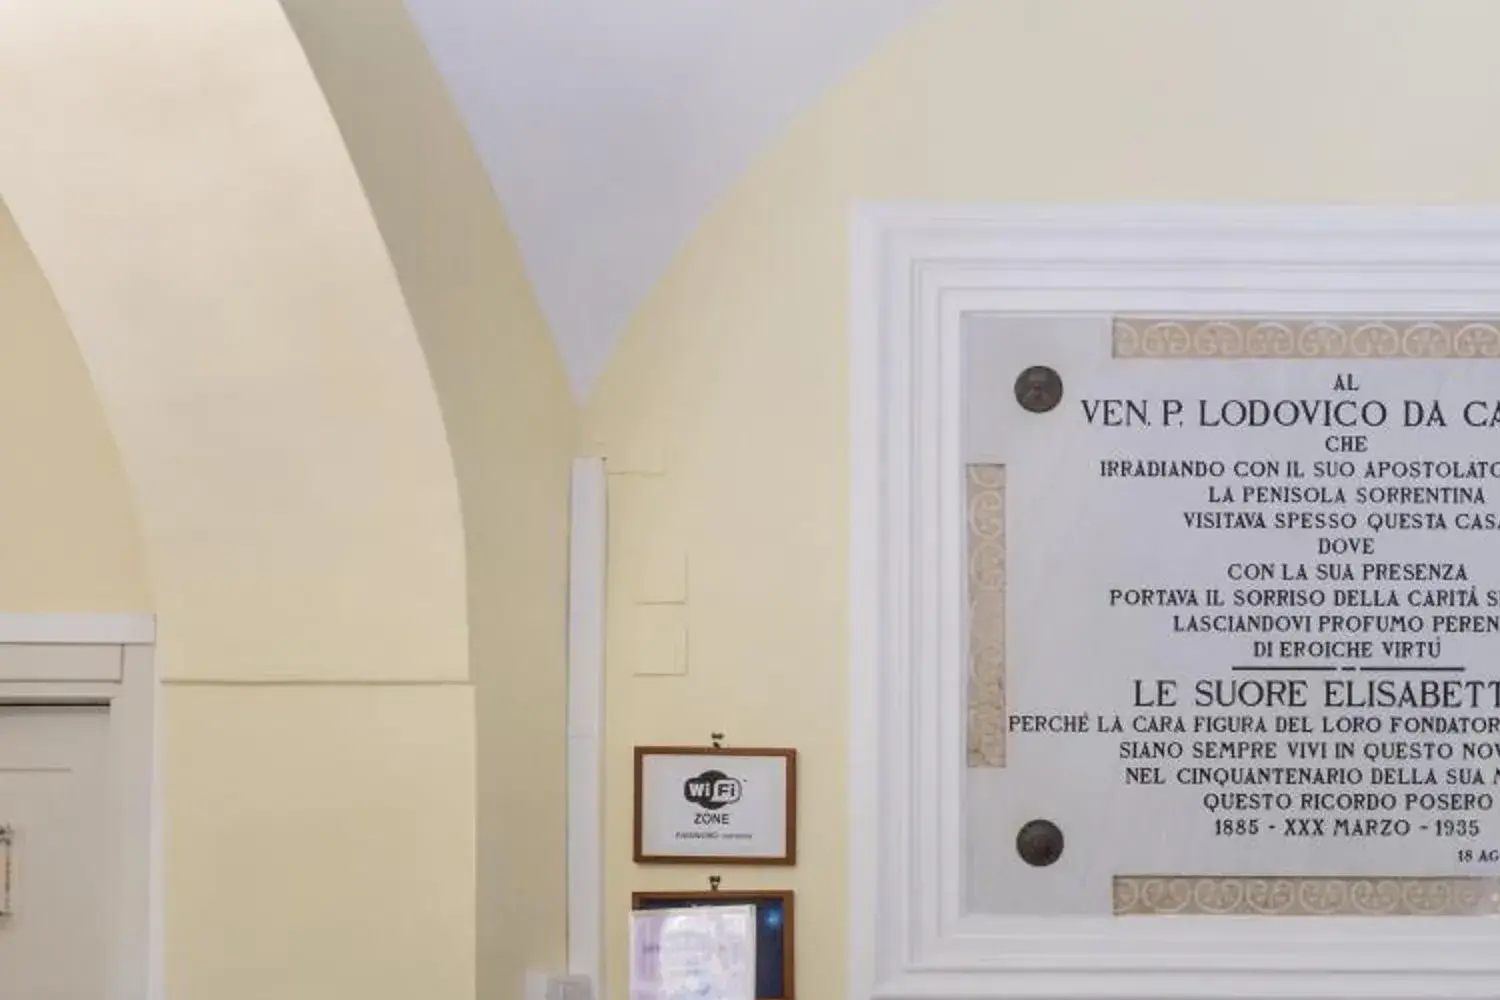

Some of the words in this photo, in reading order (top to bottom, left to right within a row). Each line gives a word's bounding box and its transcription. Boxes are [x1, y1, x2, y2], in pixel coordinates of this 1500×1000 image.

[1332, 372, 1360, 391] AL
[1079, 399, 1152, 428] VEN.
[1162, 399, 1184, 428] P.
[1199, 399, 1388, 428] LODOVICO
[1403, 399, 1449, 428] DA
[1324, 435, 1369, 453] CHE
[1099, 459, 1226, 479] IRRADIANDO
[1232, 460, 1280, 479] CON
[1285, 459, 1305, 479] IL
[1313, 460, 1356, 479] SUO
[1207, 485, 1236, 505] LA
[1242, 485, 1347, 505] PENISOLA
[1356, 486, 1486, 505] SORRENTINA
[1183, 511, 1268, 530] VISITAVA
[1273, 511, 1358, 530] SPESSO
[1366, 511, 1448, 534] QUESTA
[1317, 537, 1375, 556] DOVE
[1227, 562, 1276, 582] CON
[1280, 562, 1309, 582] LA
[1315, 563, 1355, 582] SUA
[1362, 562, 1469, 582] PRESENZA
[1108, 588, 1200, 607] PORTAVA
[1205, 588, 1226, 607] IL
[1232, 588, 1326, 607] SORRISO
[1333, 588, 1401, 608] DELLA
[1172, 614, 1312, 633] LASCIANDOVI
[1318, 615, 1425, 634] PROFUMO
[1253, 640, 1274, 658] DI
[1279, 640, 1373, 659] EROICHE
[1133, 679, 1177, 708] LE
[1194, 679, 1309, 708] SUORE
[1096, 714, 1125, 734] LA
[1131, 714, 1187, 734] CARA
[1193, 714, 1269, 734] FIGURA
[1274, 715, 1314, 734] DEL
[1321, 715, 1383, 734] LORO
[1119, 740, 1184, 760] SIANO
[1191, 740, 1278, 760] SEMPRE
[1286, 741, 1328, 760] VIVI
[1334, 741, 1355, 760] IN
[1363, 741, 1454, 763] QUESTO
[1125, 766, 1167, 785] NEL
[1175, 767, 1364, 789] CINQUANTENARIO
[1370, 767, 1439, 786] DELLA
[1445, 767, 1486, 786] SUA
[1202, 791, 1293, 814] QUESTO
[1300, 792, 1398, 812] RICORDO
[1404, 792, 1494, 812] POSERO
[693, 812, 730, 826] ZONE
[1214, 817, 1260, 838] 1885
[1283, 817, 1325, 837] XXX
[1332, 818, 1412, 838] MARZO
[1435, 818, 1481, 838] 1935
[1457, 849, 1474, 863] 18
